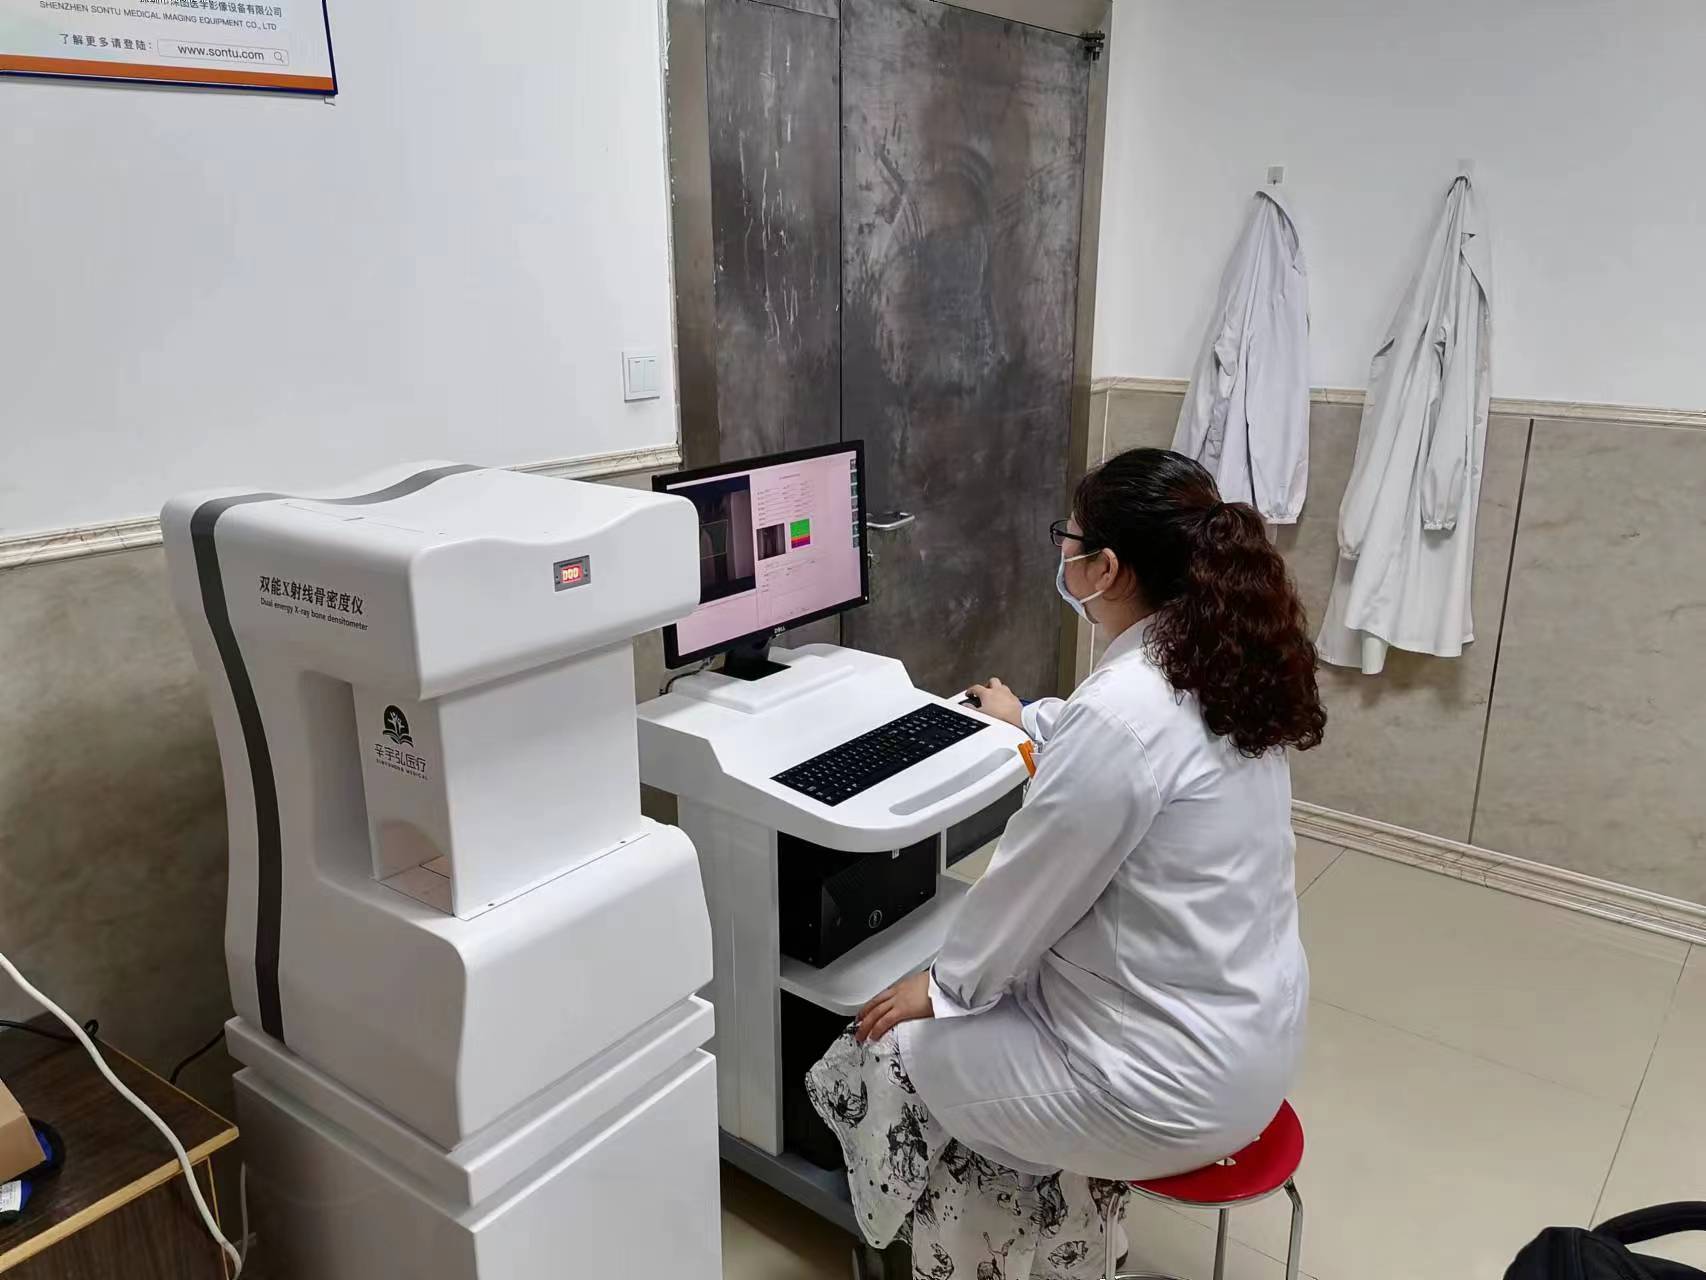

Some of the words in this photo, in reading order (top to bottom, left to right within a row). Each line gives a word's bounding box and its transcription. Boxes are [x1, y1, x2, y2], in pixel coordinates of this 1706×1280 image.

[40, 1, 88, 12] SHENZHEN
[91, 5, 121, 15] SONTU
[123, 9, 161, 20] MEDICAL
[162, 12, 197, 23] IMAGING
[199, 17, 243, 27] EQUIPMENT
[263, 23, 277, 31] LTD
[140, 0, 282, 17] 深图医学影像设备有限公司
[177, 45, 265, 60] www.sontu.com
[259, 575, 363, 616] 双能X射线骨密度仪
[260, 596, 273, 607] Dual
[274, 602, 293, 614] energy
[294, 605, 310, 618] X-ray
[311, 609, 326, 620] bone
[327, 614, 369, 631] densitometer
